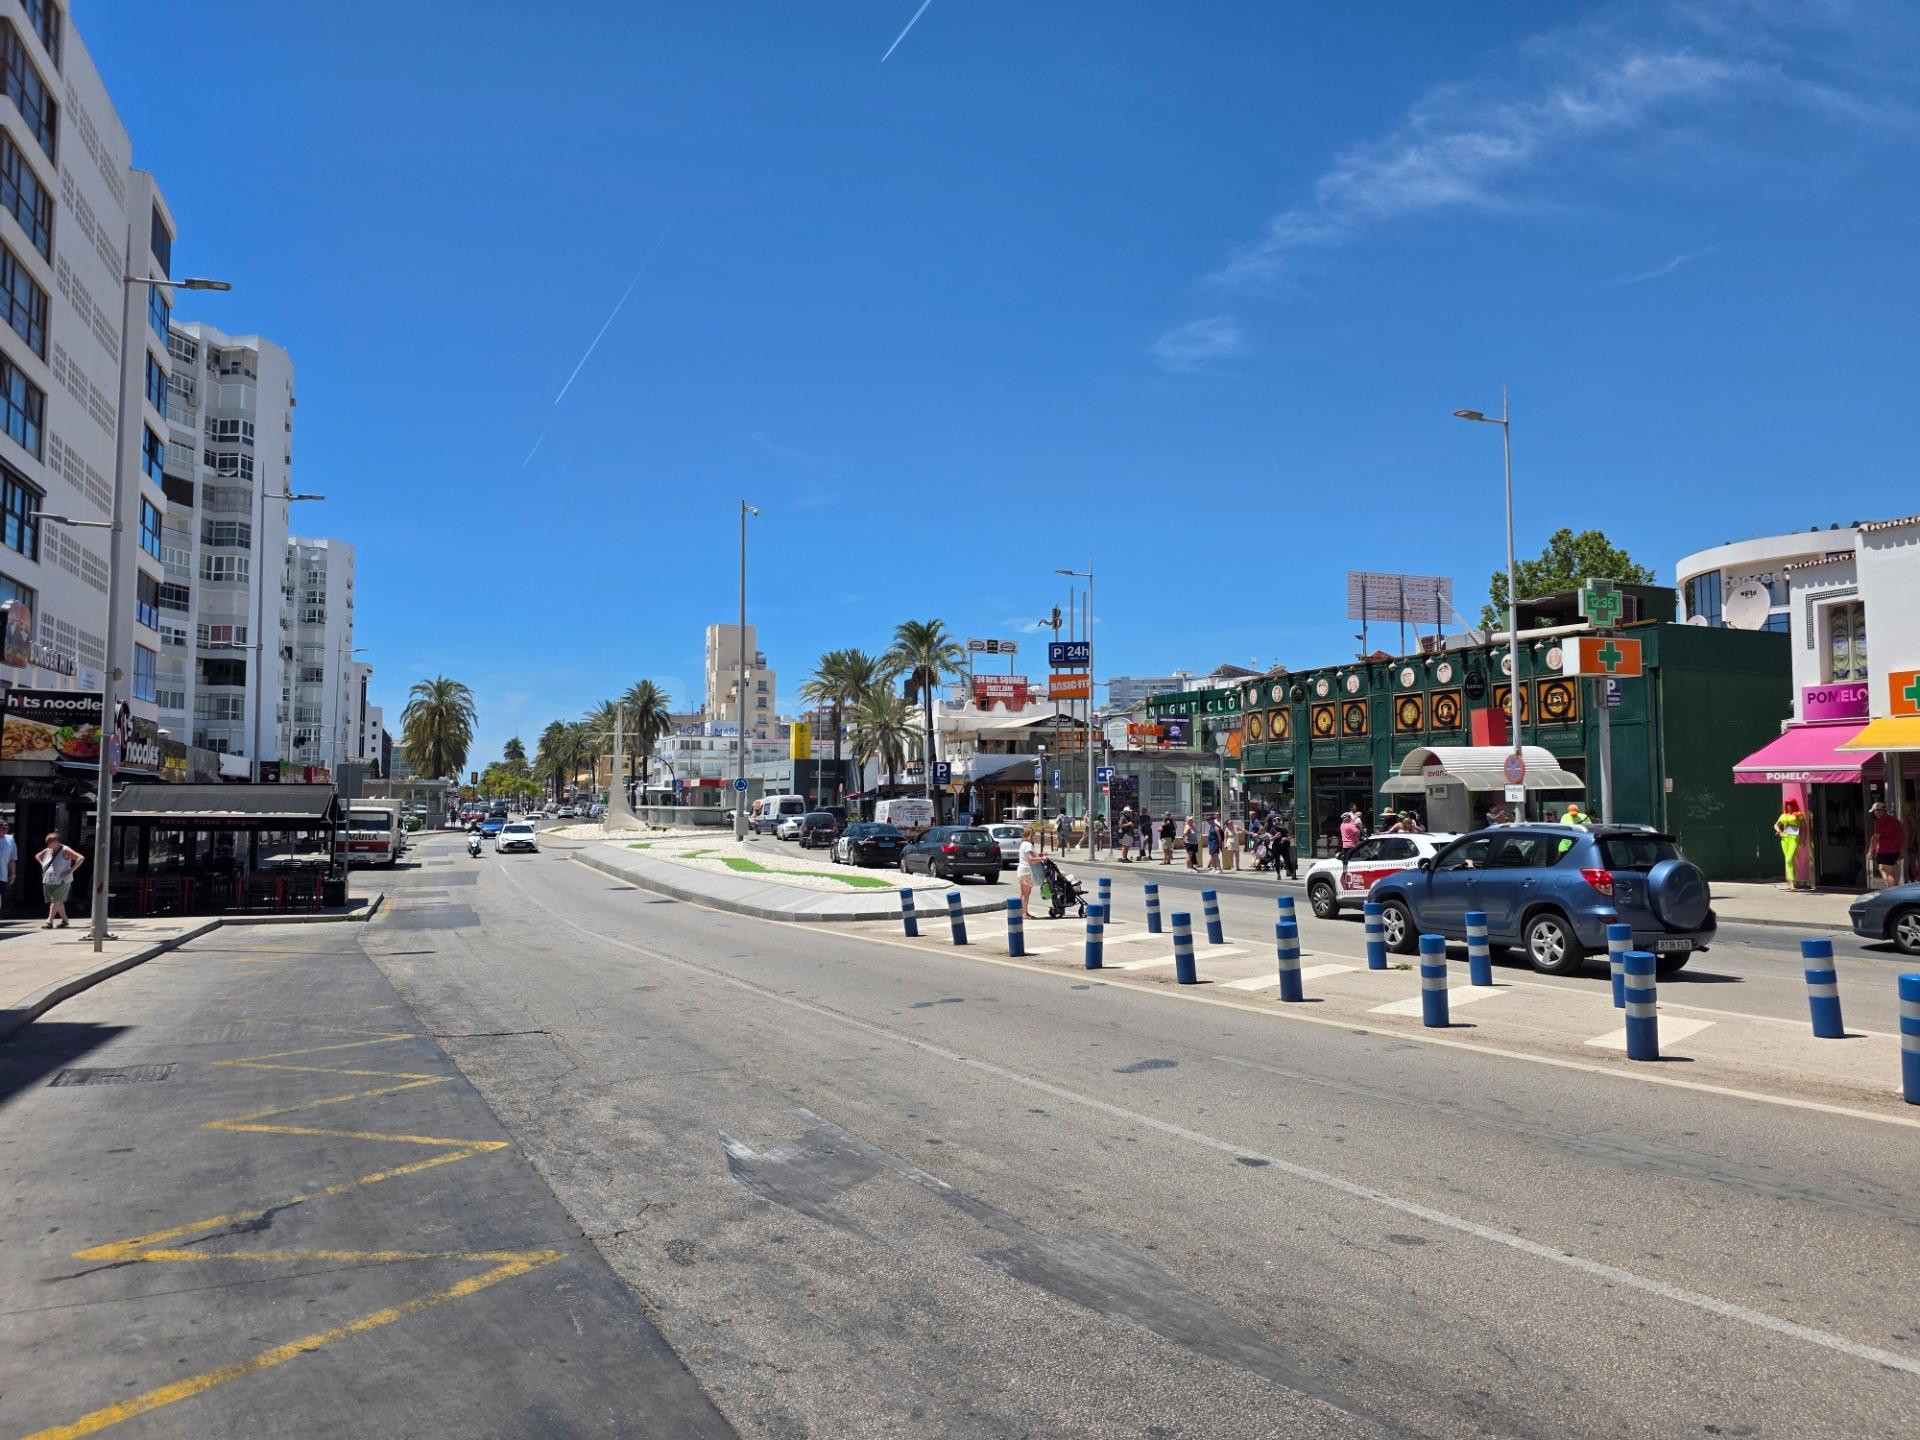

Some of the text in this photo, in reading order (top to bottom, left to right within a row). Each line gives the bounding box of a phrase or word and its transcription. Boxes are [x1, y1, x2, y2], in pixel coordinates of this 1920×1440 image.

[1053, 646, 1089, 658] P 24h
[1050, 679, 1089, 692] BASIC-FIT
[1606, 679, 1616, 696] P
[1148, 697, 1236, 718] NIGHT CLU
[714, 727, 751, 736] MARIA
[126, 738, 160, 766] noodles
[936, 763, 948, 777] P
[1766, 772, 1810, 781] POMELO
